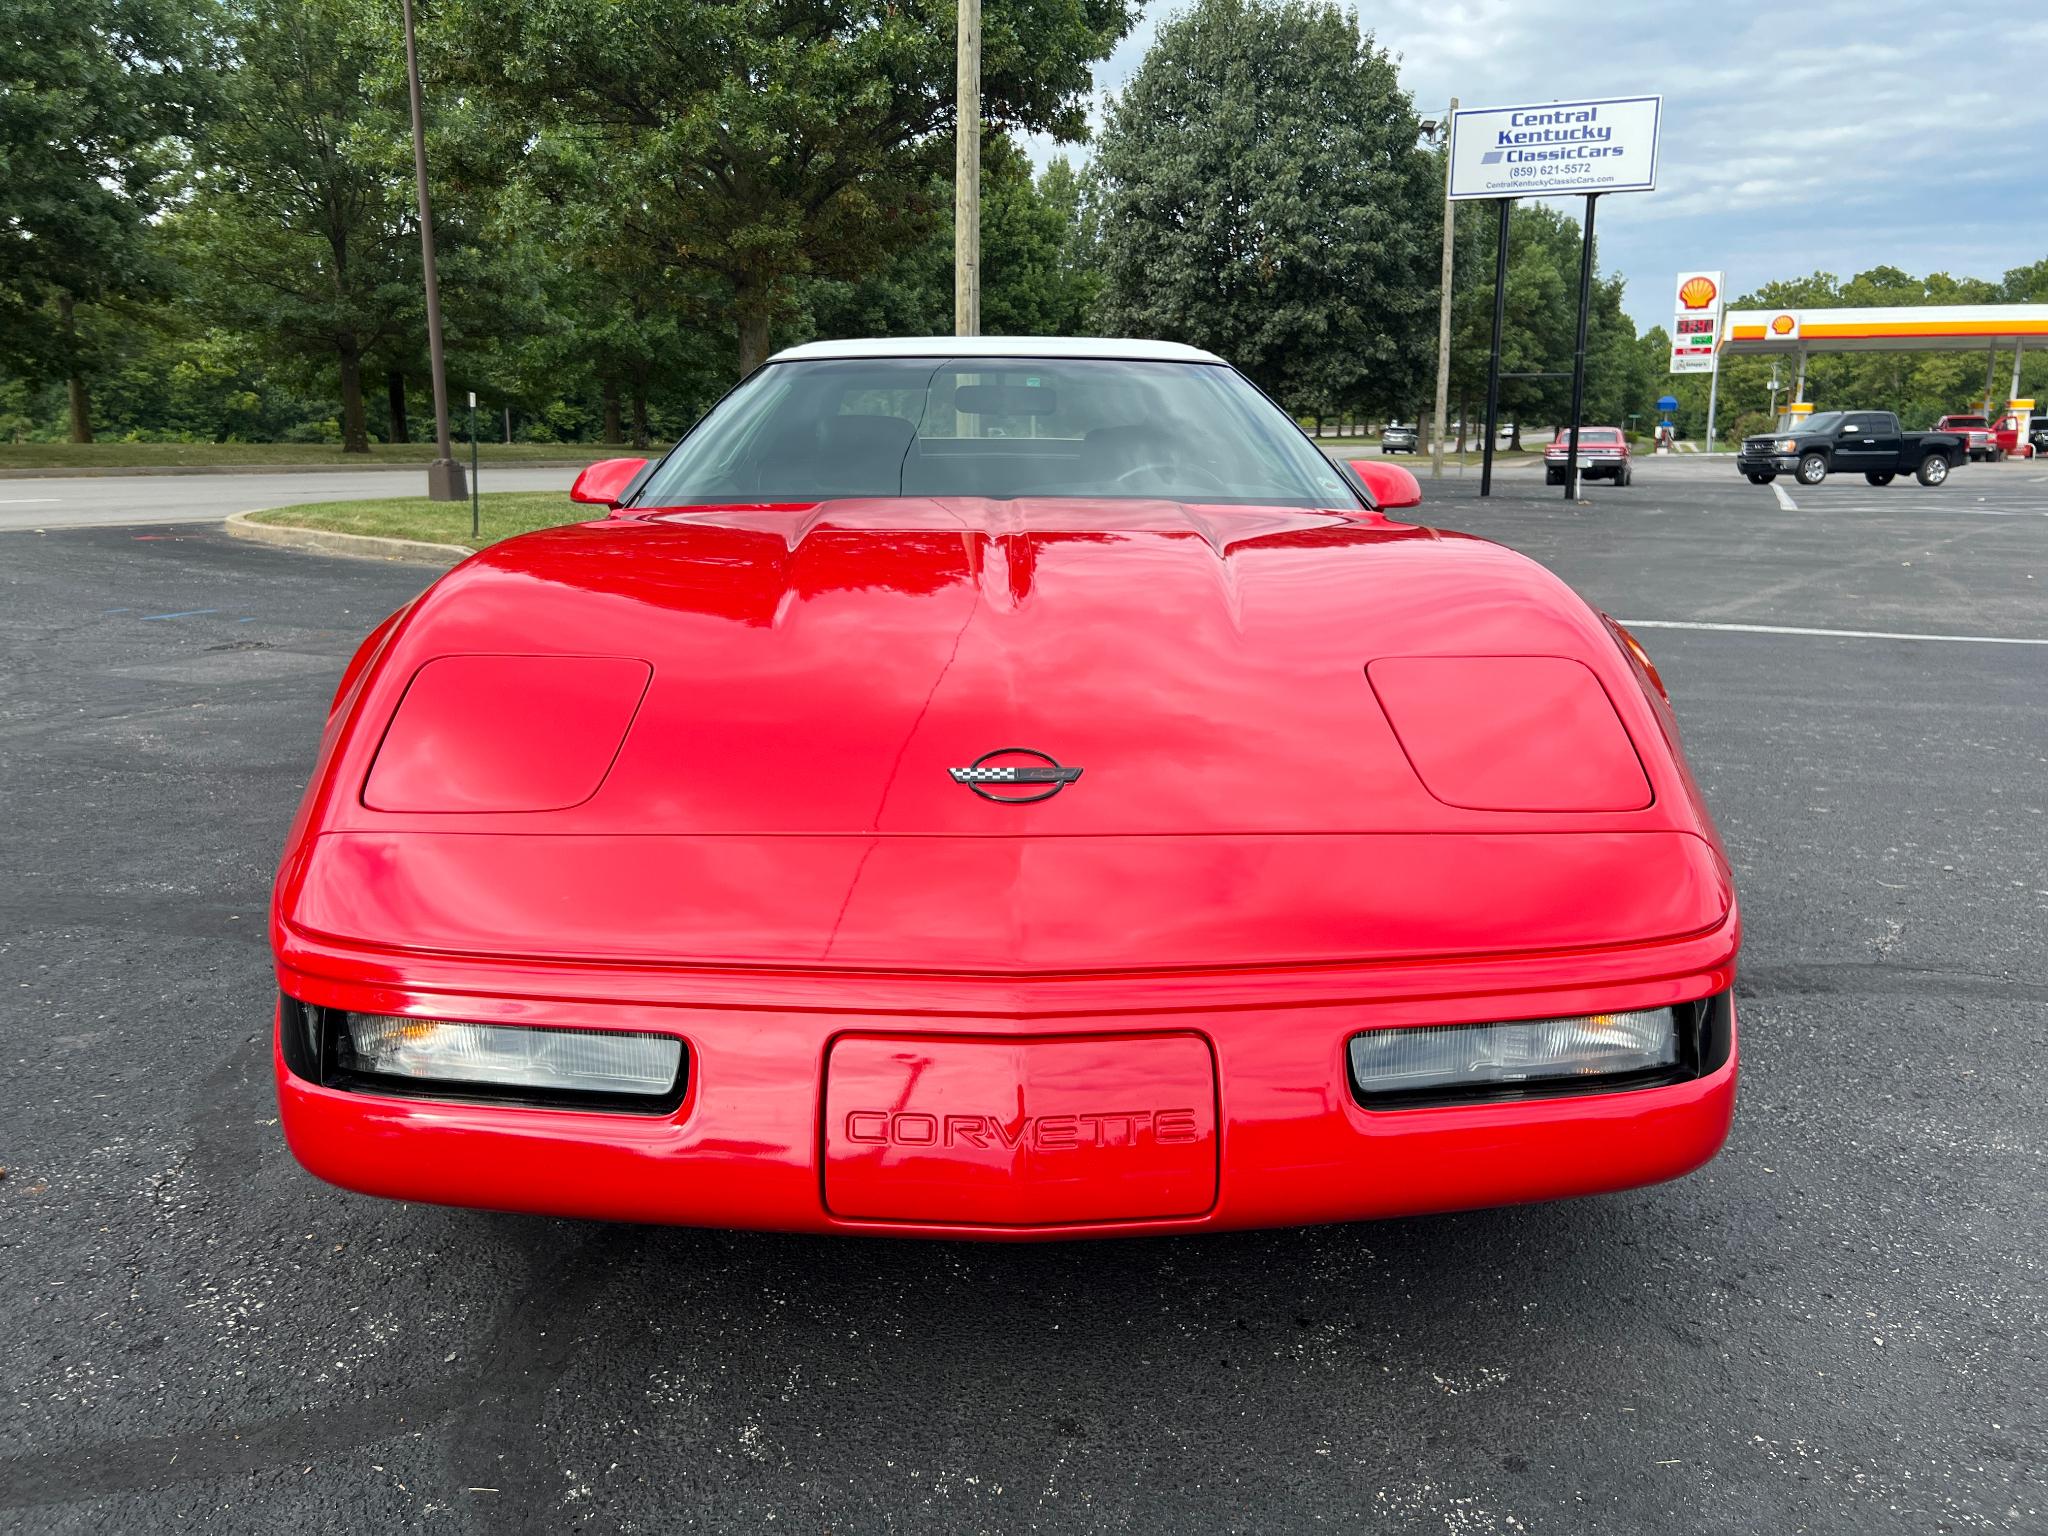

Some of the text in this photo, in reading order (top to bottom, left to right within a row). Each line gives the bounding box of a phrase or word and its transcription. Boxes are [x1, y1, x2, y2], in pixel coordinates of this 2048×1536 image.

[1511, 107, 1598, 127] Central
[1498, 125, 1612, 144] Kentucky
[1506, 145, 1624, 163] ClassicCars
[1509, 163, 1591, 179] (859) 621-5572
[1486, 175, 1615, 189] CentralKentuckyClassicCars.com
[845, 1108, 1197, 1151] CORVETTE
